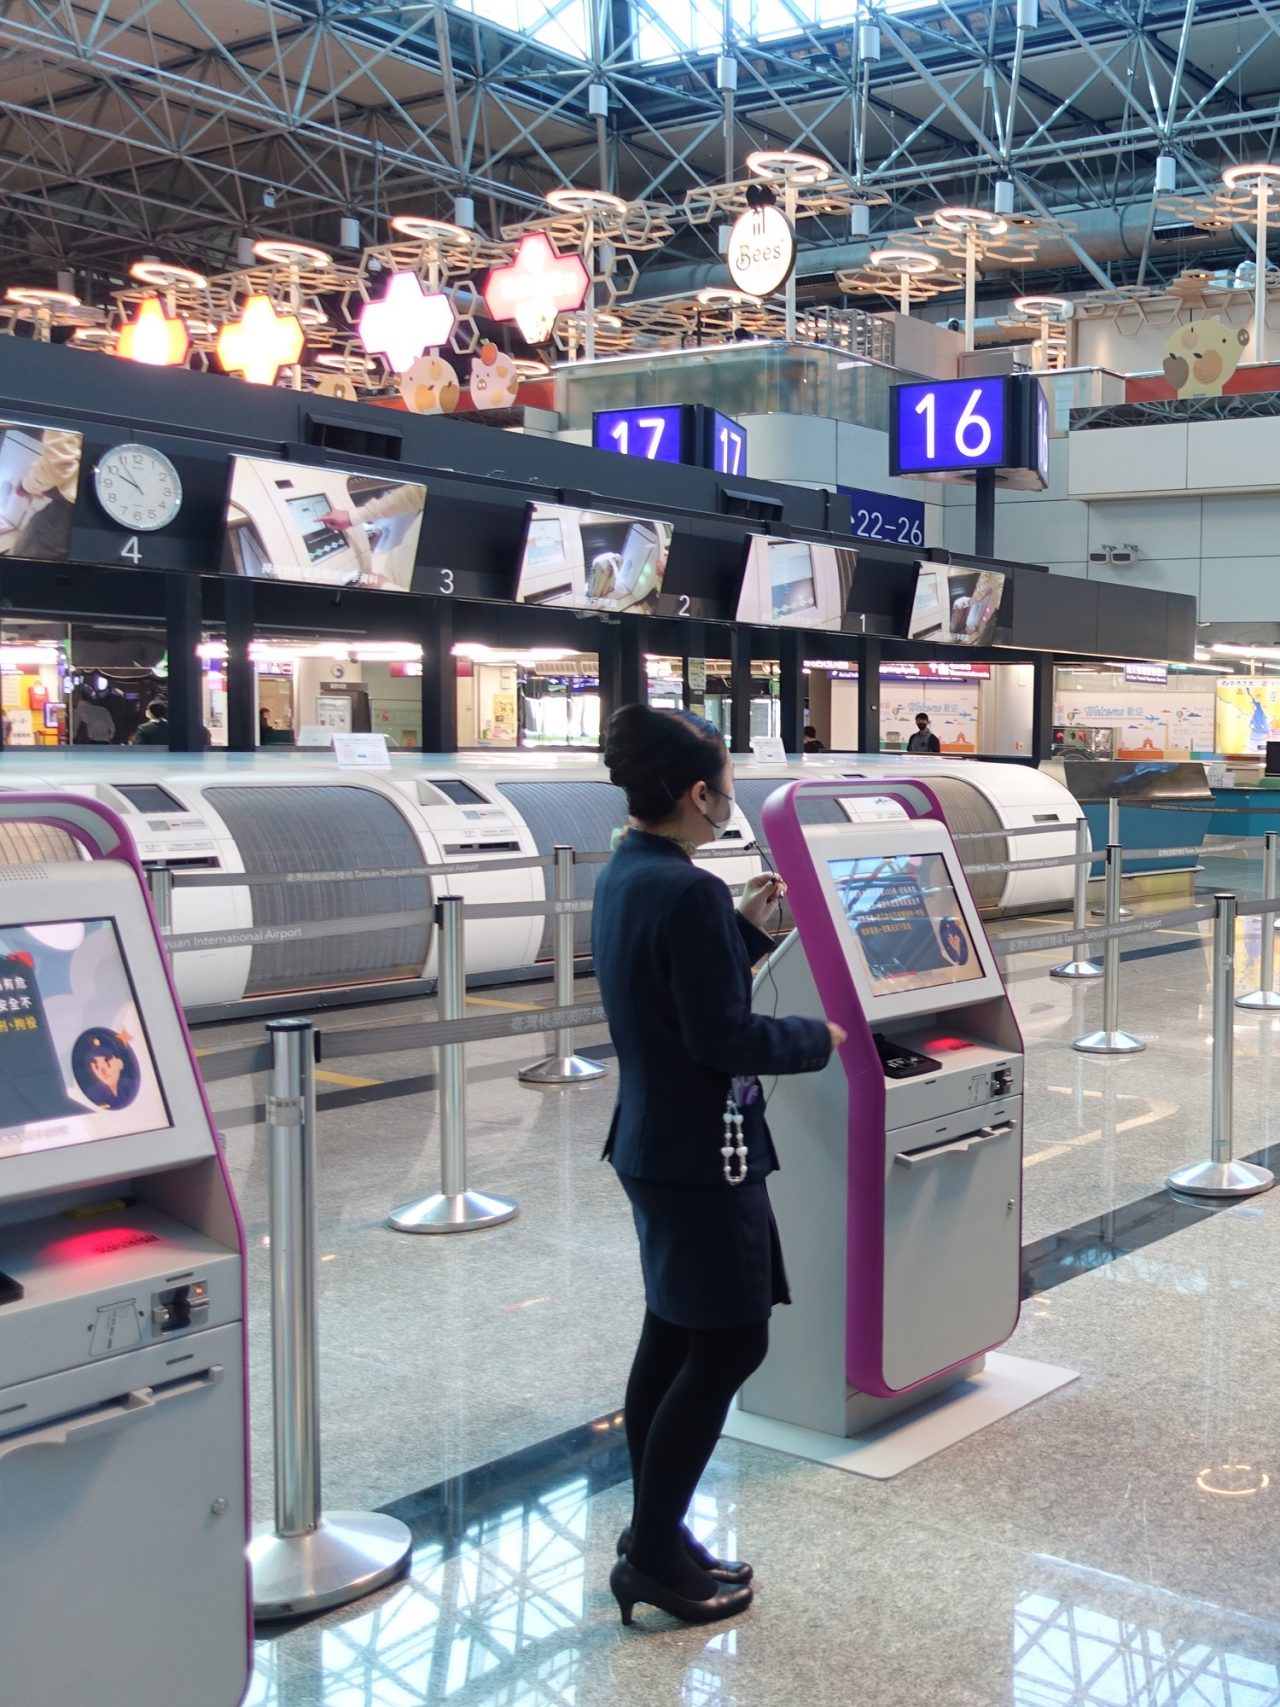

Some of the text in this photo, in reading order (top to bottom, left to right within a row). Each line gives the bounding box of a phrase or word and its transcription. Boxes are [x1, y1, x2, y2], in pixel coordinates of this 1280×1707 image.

[736, 244, 781, 271] Bees
[915, 389, 991, 459] 16
[611, 418, 666, 460] 17
[720, 427, 742, 476] 17
[857, 509, 923, 546] 22-26
[120, 535, 143, 564] 4
[439, 569, 454, 594] 3
[678, 595, 691, 617] 2
[860, 613, 866, 633] 1
[193, 932, 263, 946] International
[264, 927, 303, 941] Airport
